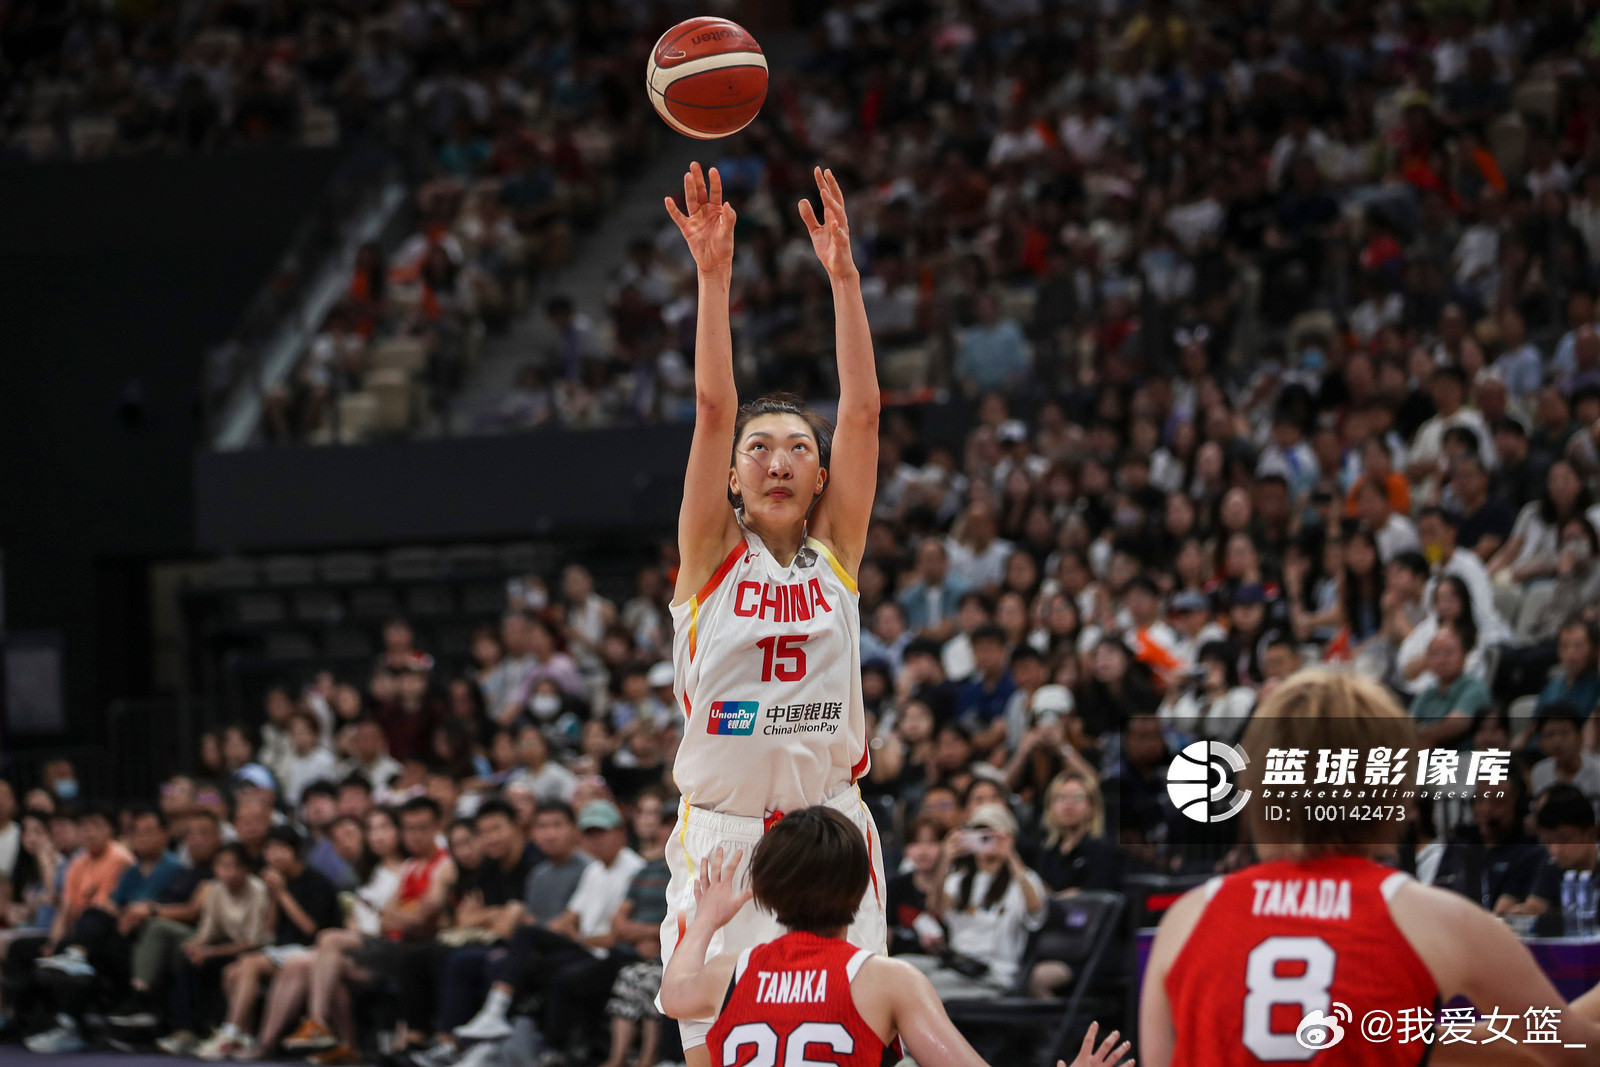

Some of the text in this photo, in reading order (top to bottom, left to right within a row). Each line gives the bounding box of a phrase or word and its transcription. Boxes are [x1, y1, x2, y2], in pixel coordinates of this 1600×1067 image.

[691, 28, 743, 46] molten
[733, 577, 832, 623] CHINA
[755, 634, 809, 682] 15
[711, 709, 756, 721] UnionPay
[727, 719, 751, 730] 银联
[766, 702, 843, 723] 中国银联
[763, 722, 839, 736] China UnionPay
[1252, 879, 1352, 919] TAKADA
[756, 969, 828, 1004] TANAKA
[1242, 935, 1337, 1062] 8
